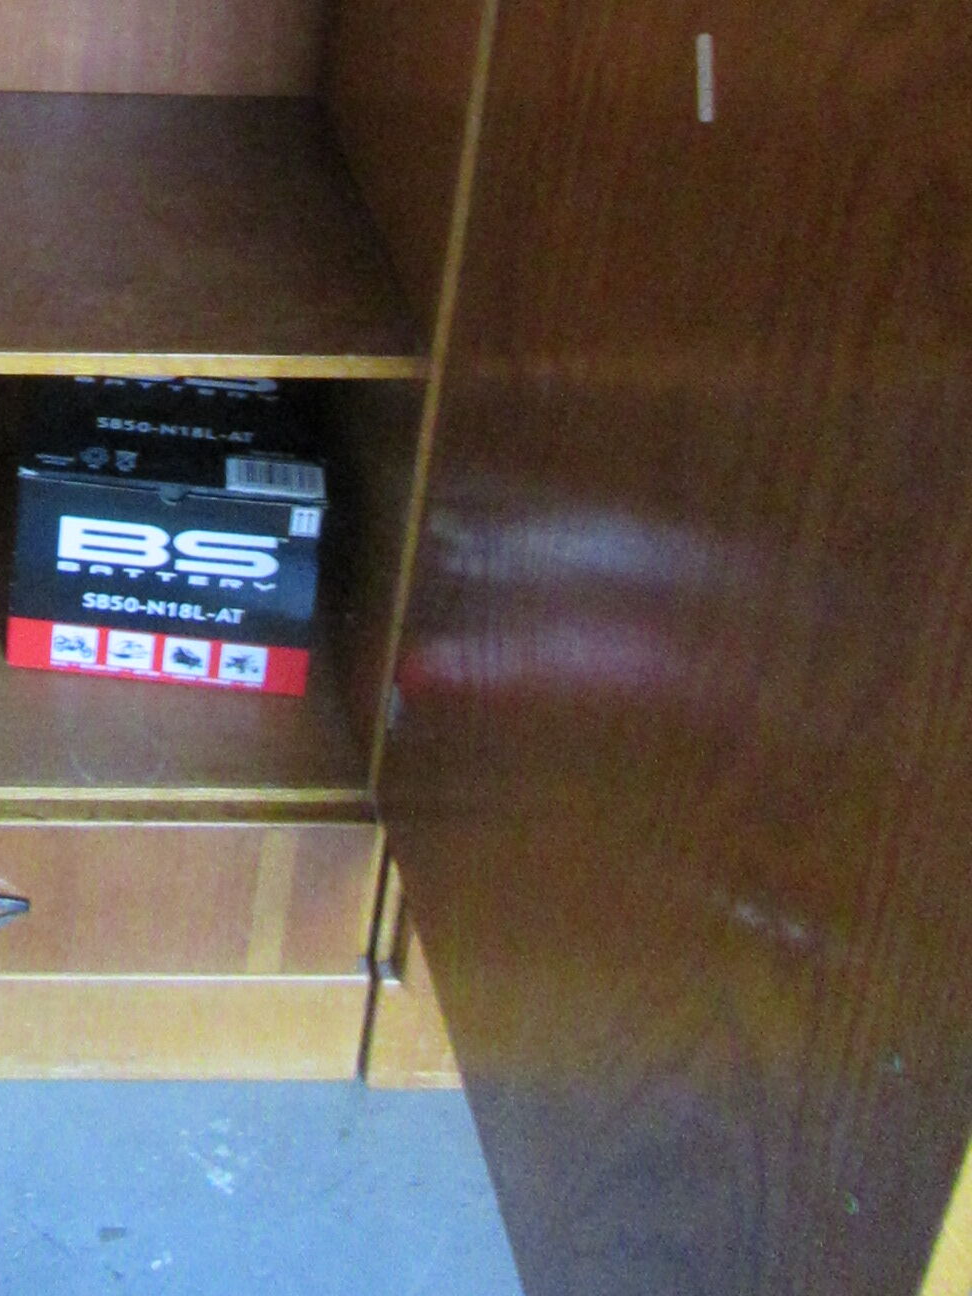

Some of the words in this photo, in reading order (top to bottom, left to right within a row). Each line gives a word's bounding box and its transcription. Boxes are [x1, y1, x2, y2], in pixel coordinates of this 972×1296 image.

[57, 514, 280, 579] BS
[56, 560, 278, 592] BATTERY
[81, 591, 246, 625] SB50-N18L-AT
